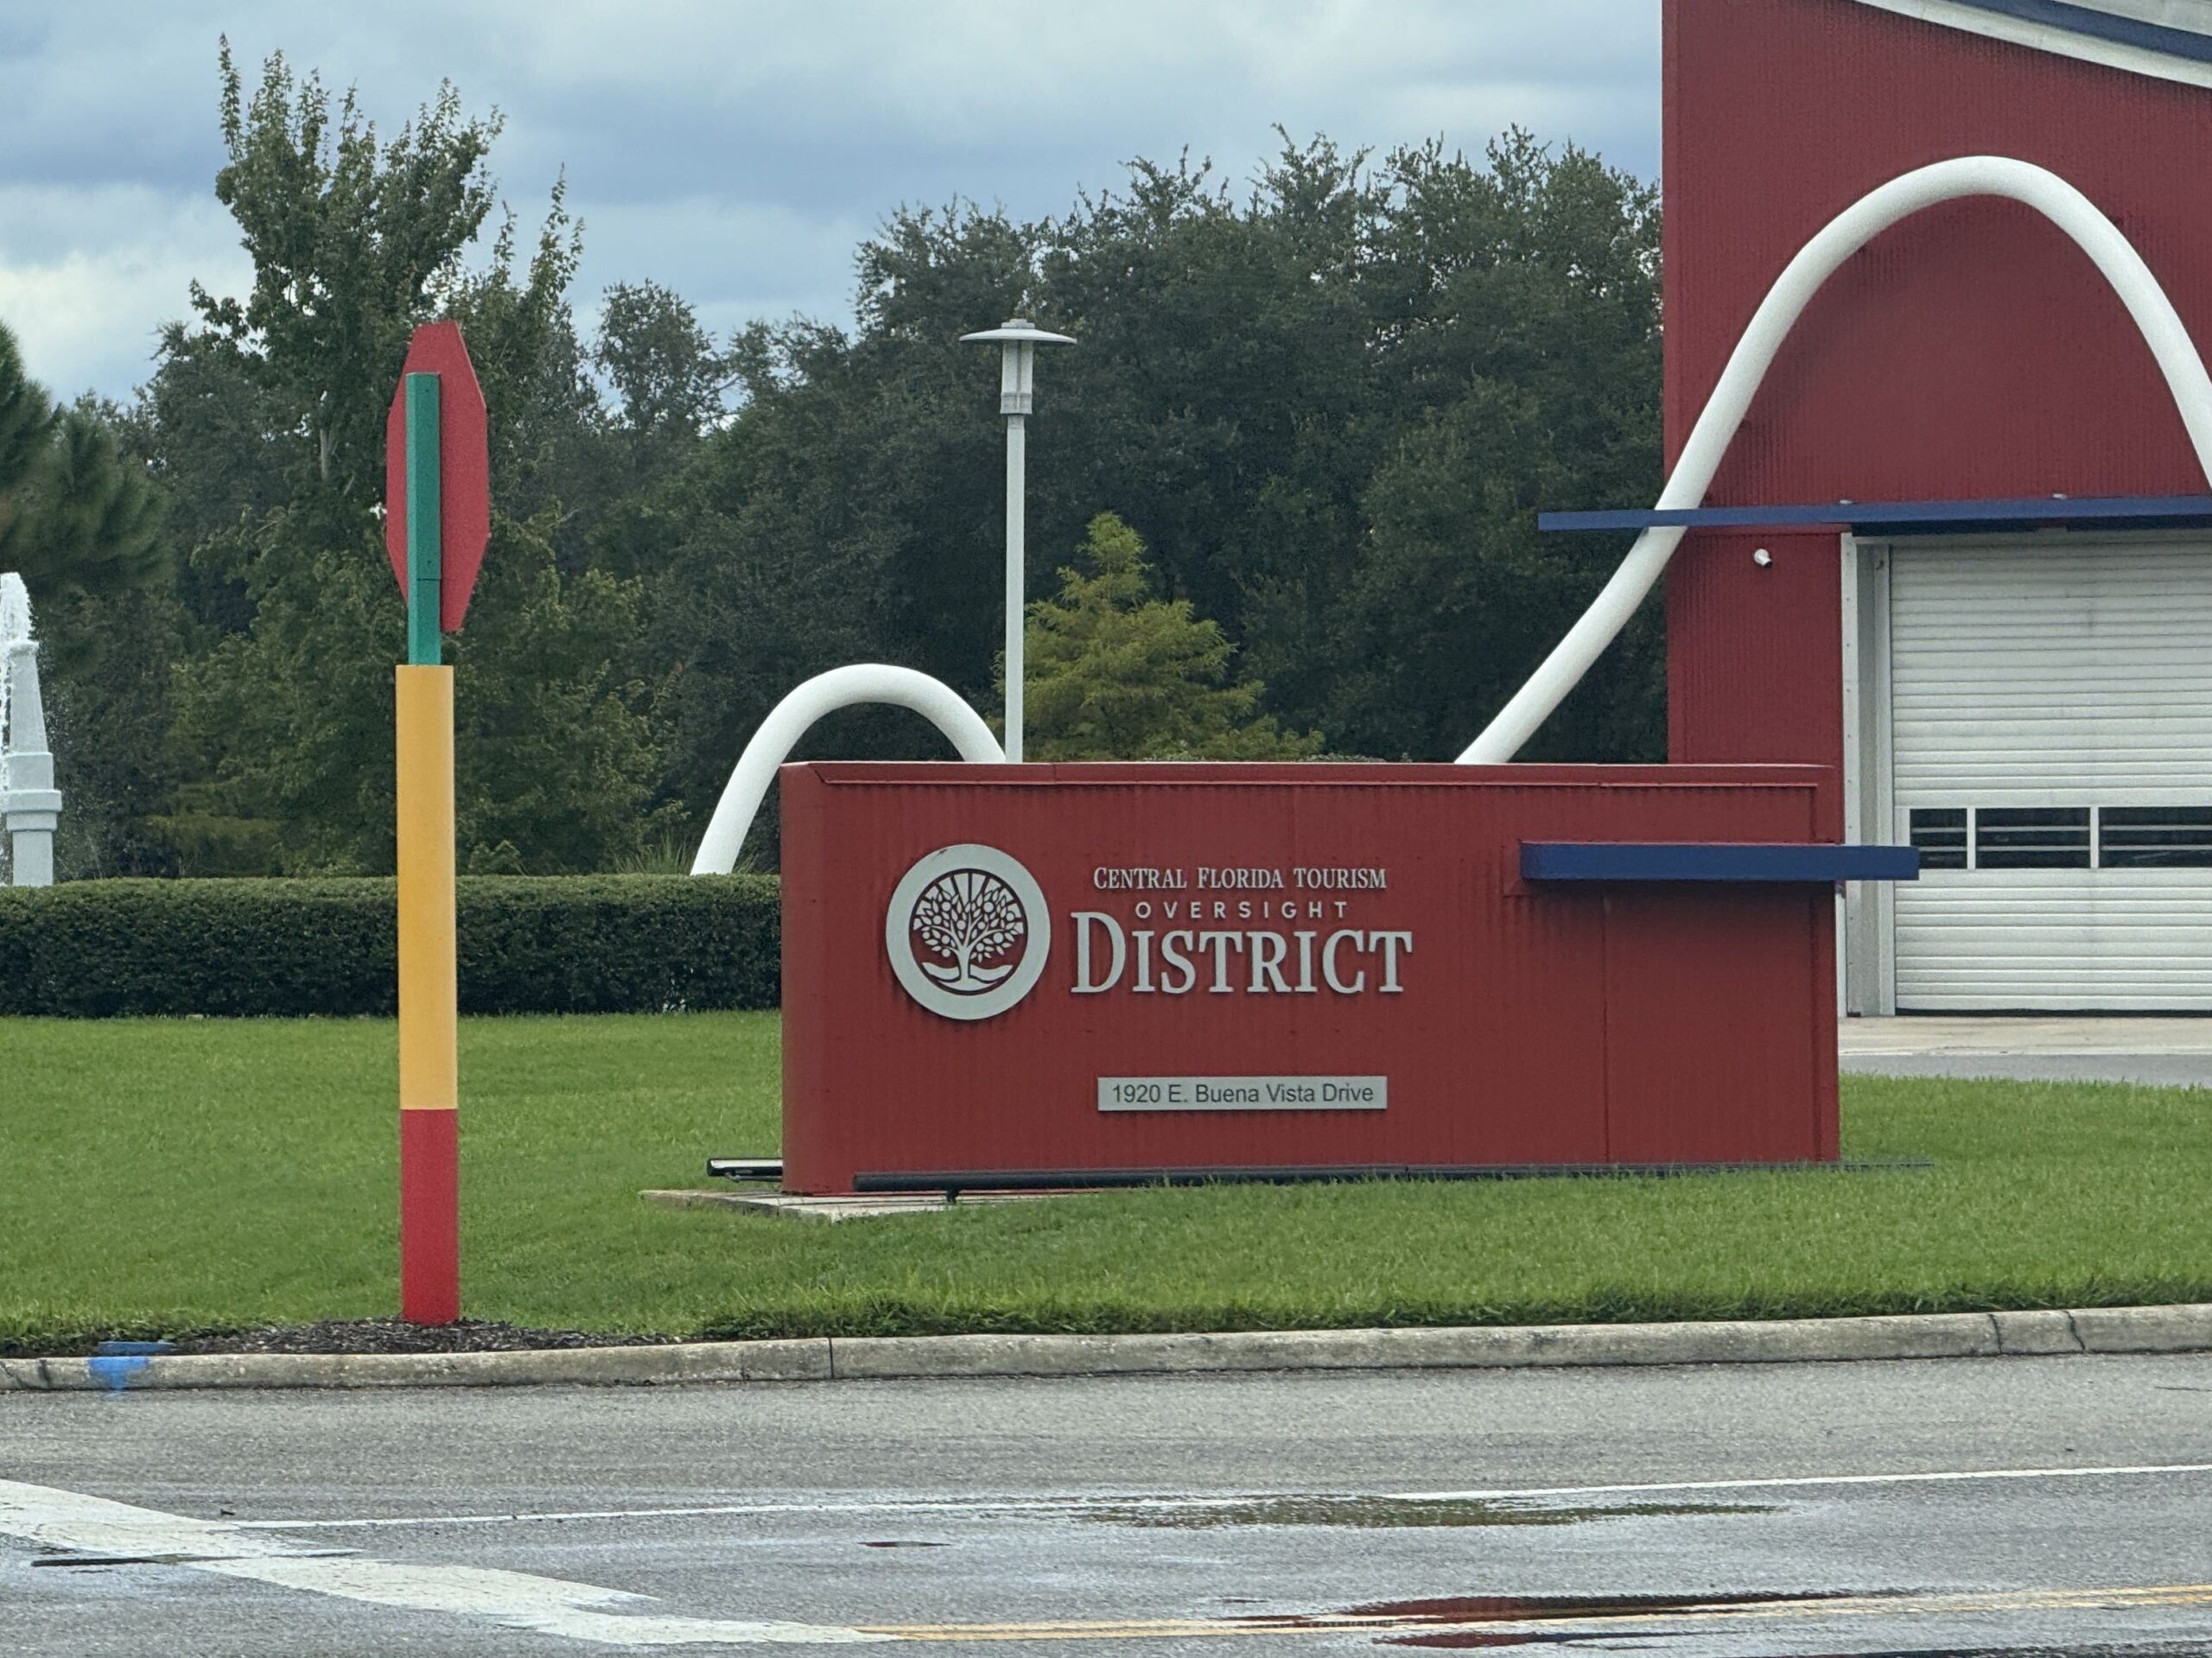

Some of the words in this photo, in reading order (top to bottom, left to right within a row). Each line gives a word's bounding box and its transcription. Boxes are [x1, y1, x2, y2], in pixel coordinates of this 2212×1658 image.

[1094, 867, 1187, 890] CENTRAL
[1198, 867, 1284, 890] FLORIDA
[1294, 867, 1387, 889] TOURISM
[1135, 901, 1350, 919] OVERSIGHT
[1071, 911, 1413, 994] DISTRICT
[1112, 1084, 1161, 1104] 1920
[1168, 1084, 1188, 1103] E.
[1196, 1084, 1260, 1104] Buena
[1265, 1084, 1316, 1103] Vista
[1323, 1083, 1374, 1102] Drive
